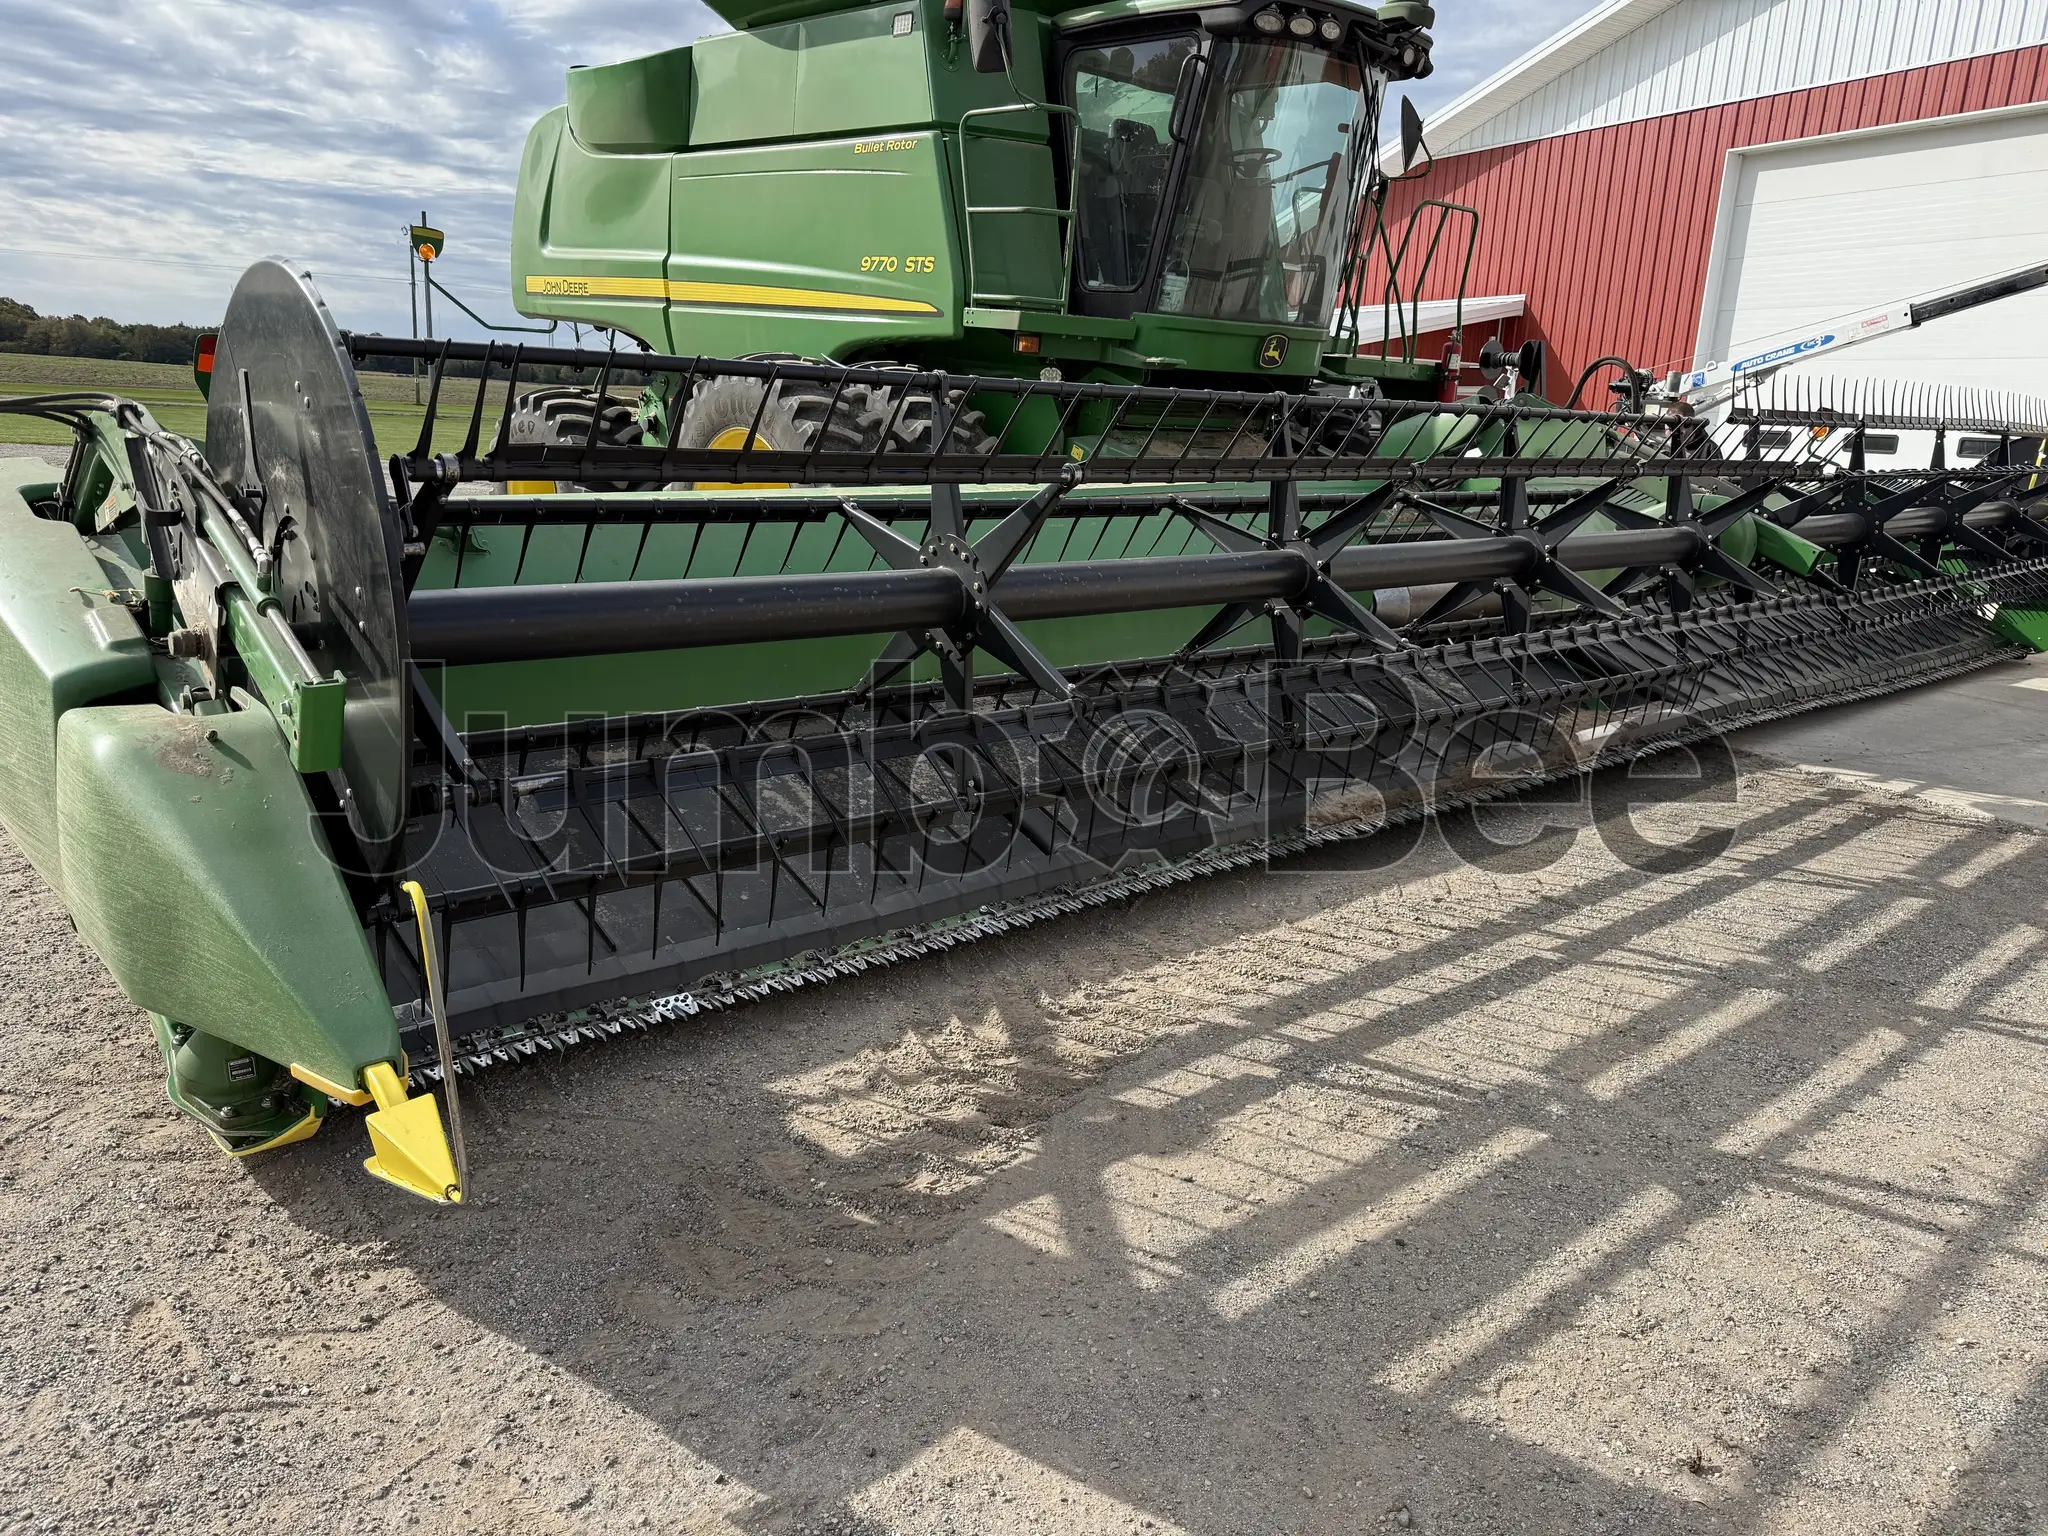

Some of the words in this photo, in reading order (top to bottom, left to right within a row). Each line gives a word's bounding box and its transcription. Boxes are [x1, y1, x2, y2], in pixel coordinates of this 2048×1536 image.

[854, 141, 884, 154] Bullet
[886, 139, 918, 151] Rotor
[860, 256, 898, 272] 9770
[904, 256, 935, 273] STS
[542, 279, 561, 293] JOHN
[562, 279, 589, 294] DEERE
[1740, 357, 1764, 369] AUTO
[1765, 347, 1796, 361] CRANE
